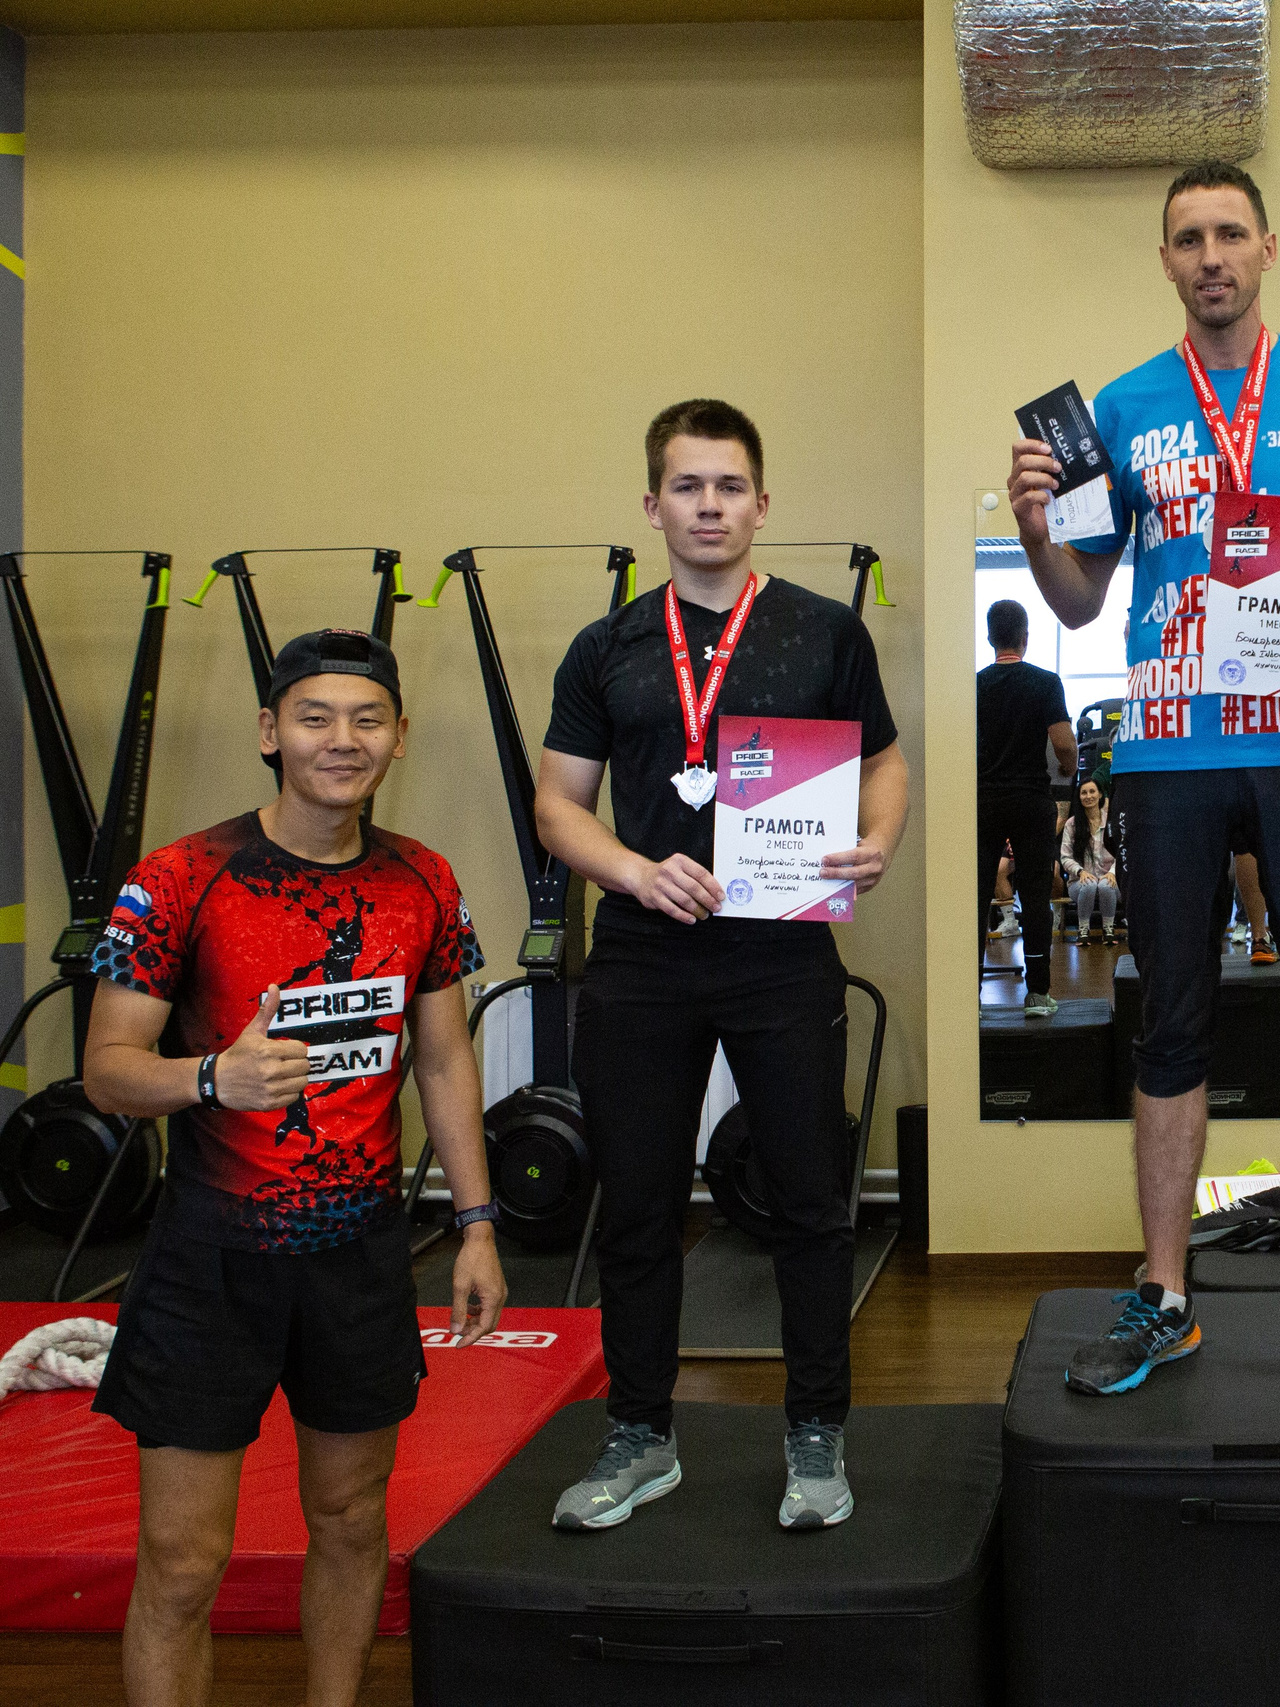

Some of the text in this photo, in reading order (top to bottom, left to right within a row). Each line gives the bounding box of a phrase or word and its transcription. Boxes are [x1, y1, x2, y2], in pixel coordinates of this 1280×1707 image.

[1184, 341, 1213, 402] CHAMPIONSHIP
[1130, 420, 1199, 473] 2024
[1216, 422, 1245, 492] CHAMPIONSHIP
[1231, 530, 1265, 538] PRIDE
[727, 581, 755, 645] CHAMPIONSHIP
[680, 666, 699, 743] CHAMPIONSHIP
[700, 666, 722, 728] CHAMPIONS
[735, 752, 769, 761] PRIDE
[744, 818, 826, 836] ГРАМОТА
[774, 840, 804, 850] МЕСТО
[805, 874, 822, 882] LIGH
[277, 986, 392, 1022] PRIDE
[306, 1046, 382, 1075] EAM
